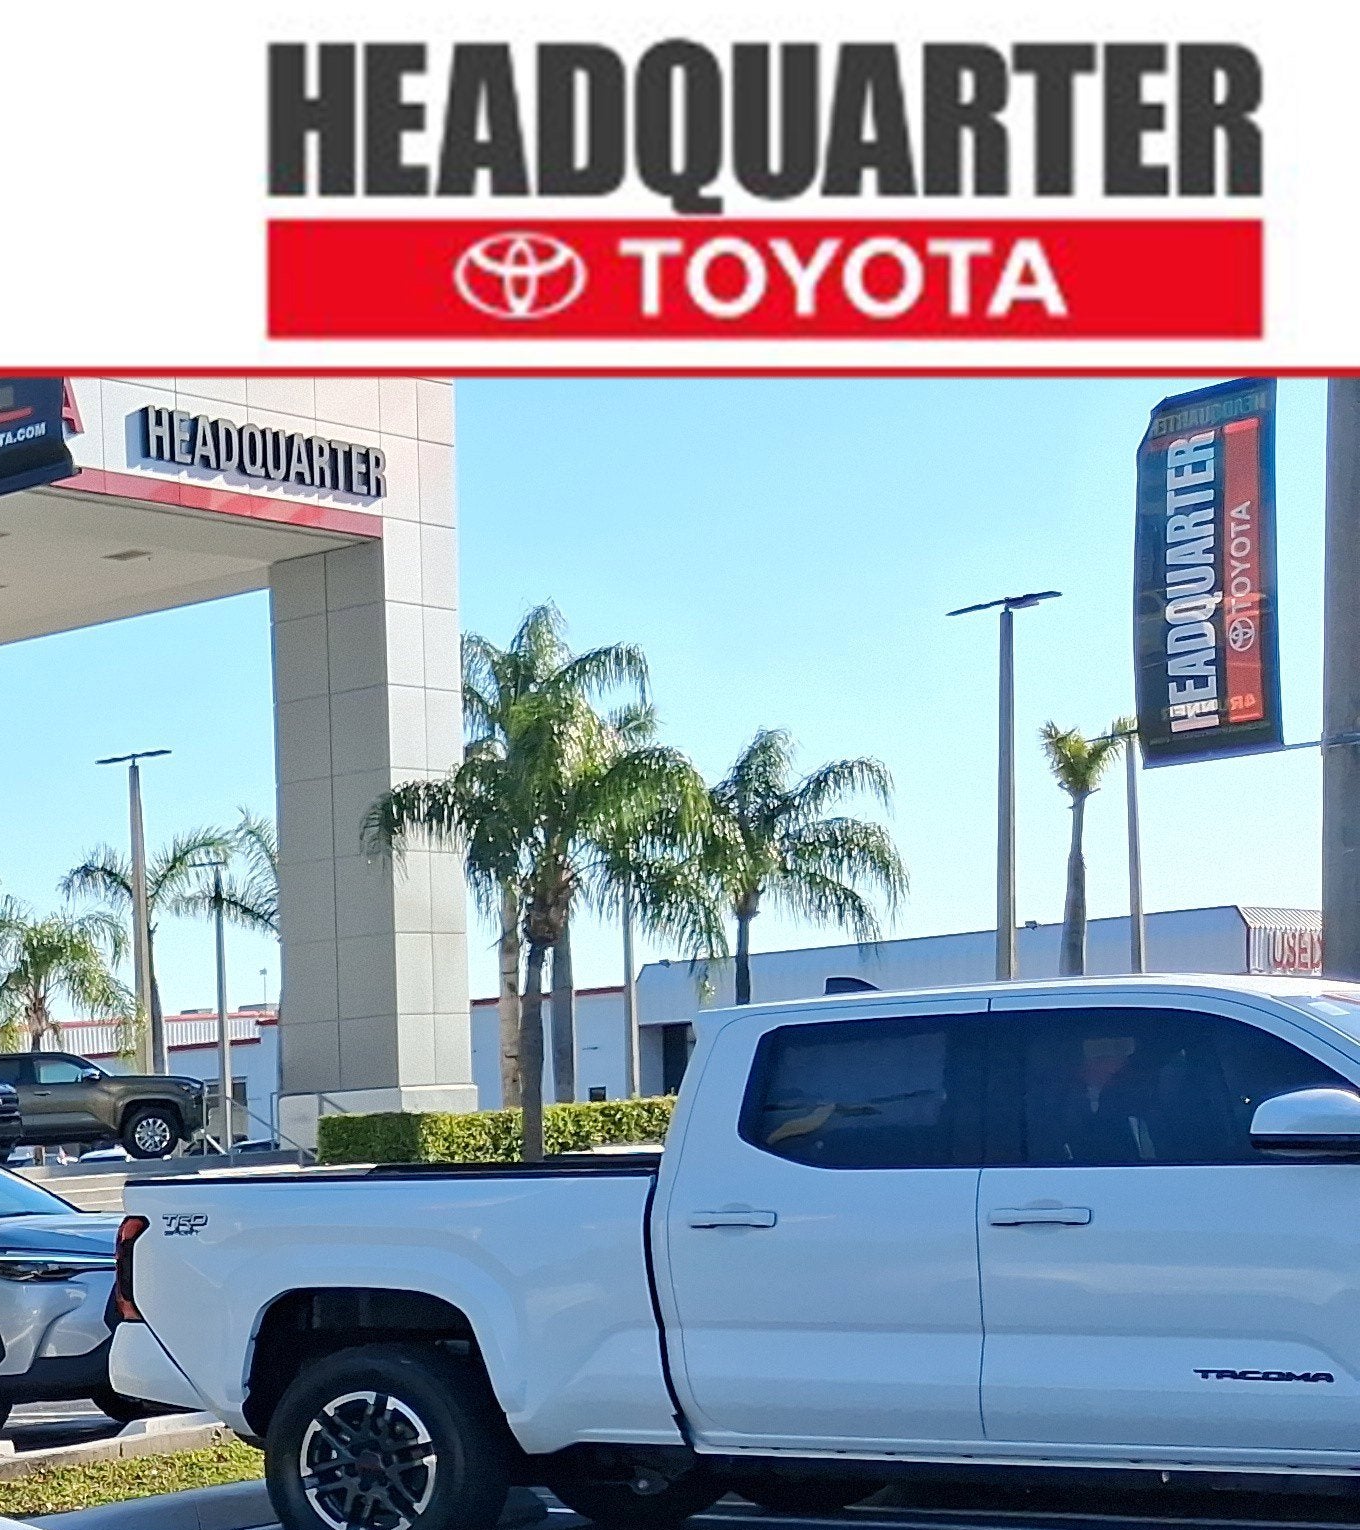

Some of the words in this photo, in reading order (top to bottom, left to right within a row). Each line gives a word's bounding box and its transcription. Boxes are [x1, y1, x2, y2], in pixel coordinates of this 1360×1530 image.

[146, 404, 387, 498] HEADQUARTER
[1165, 429, 1223, 733] HEADQUARTER
[1230, 500, 1253, 615] TOYOTA
[1270, 930, 1323, 970] USED
[1192, 1368, 1335, 1383] TACOMA
